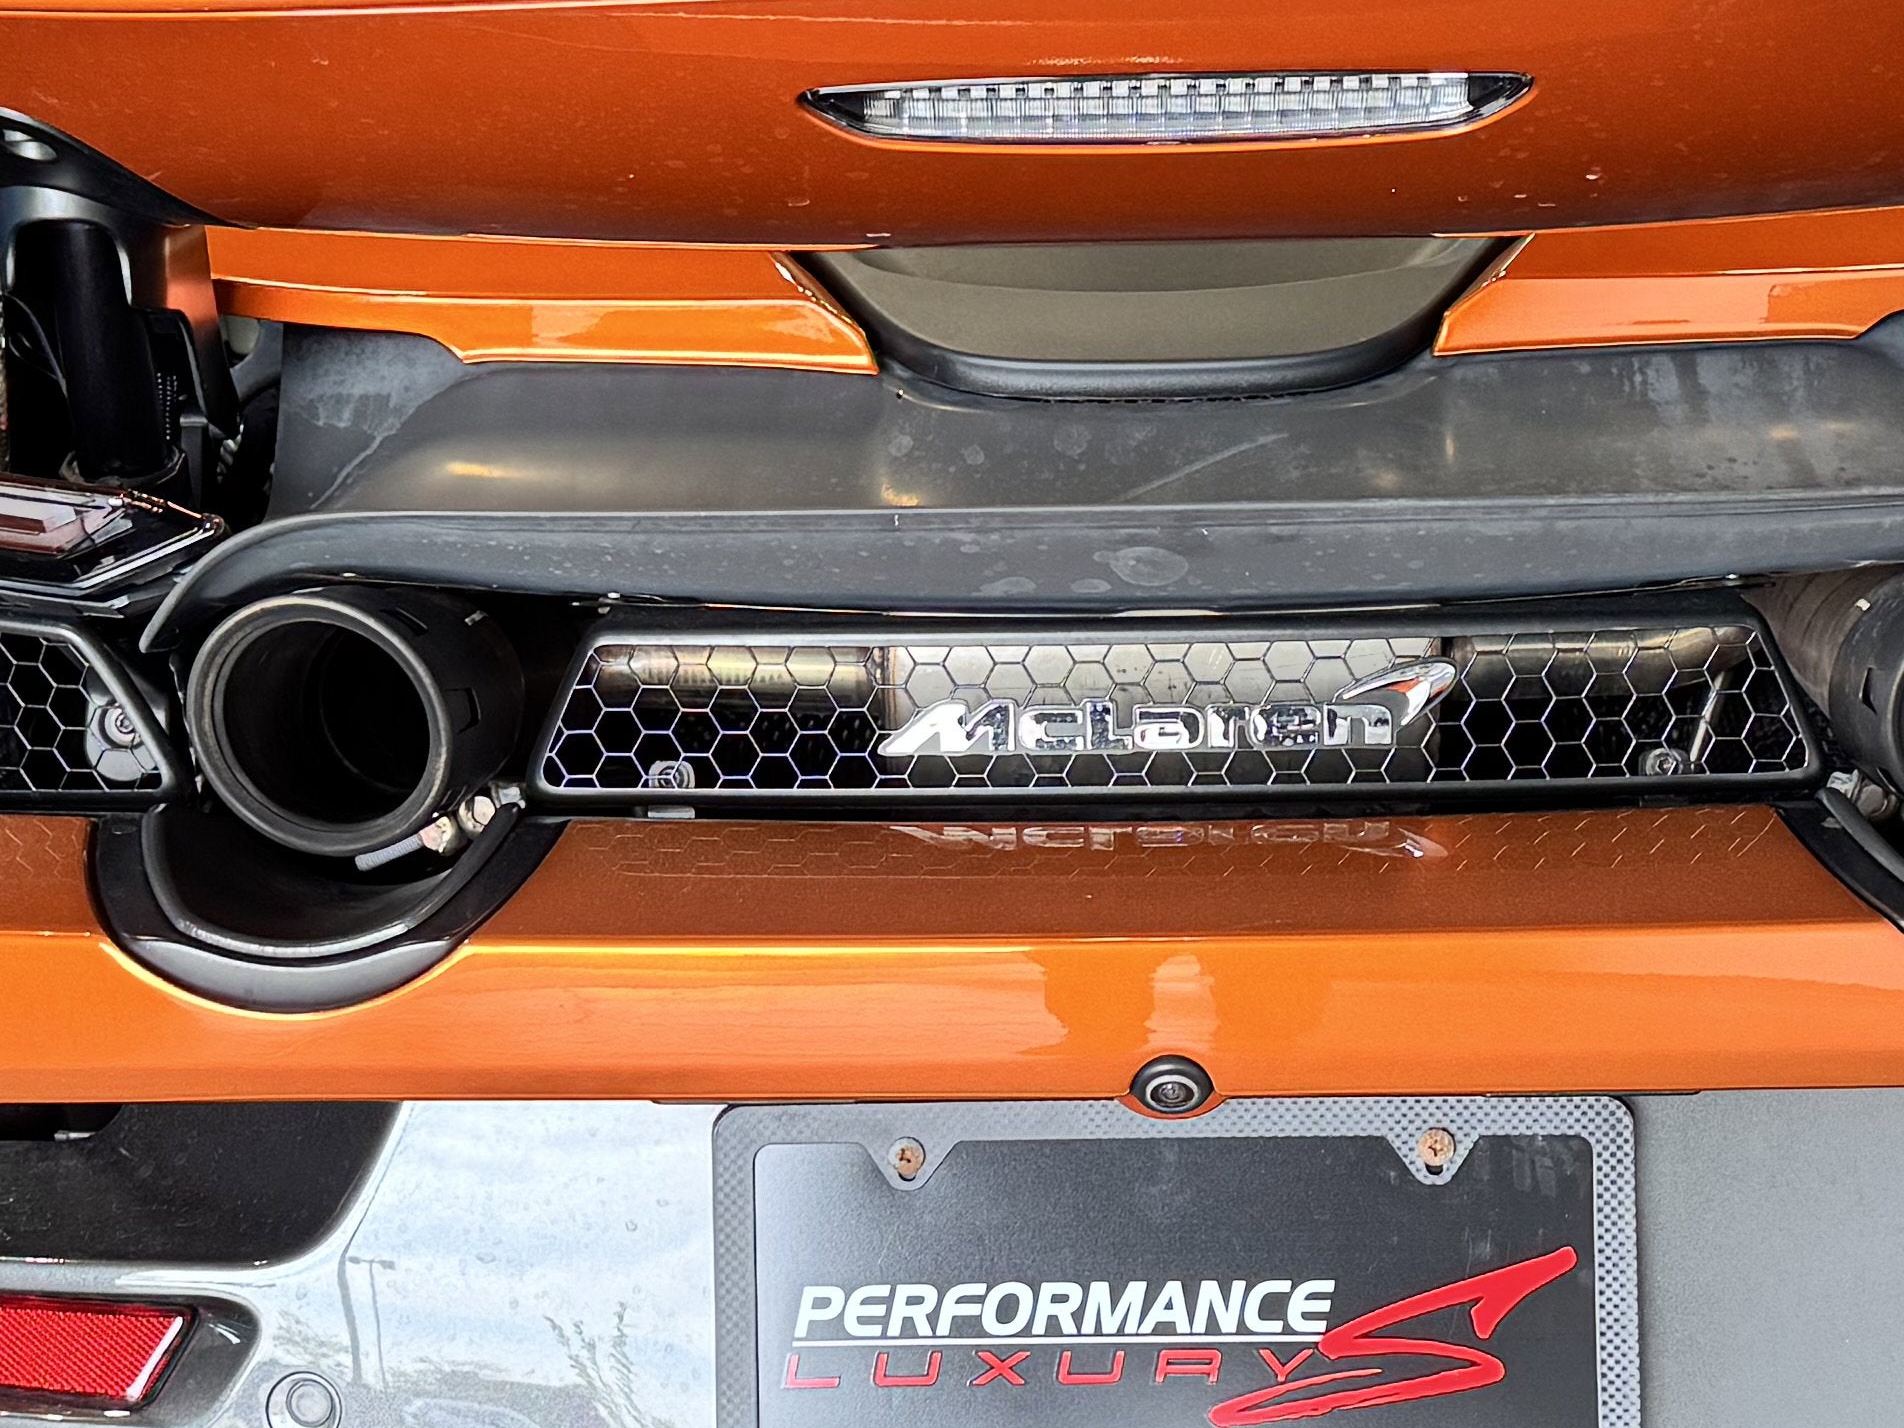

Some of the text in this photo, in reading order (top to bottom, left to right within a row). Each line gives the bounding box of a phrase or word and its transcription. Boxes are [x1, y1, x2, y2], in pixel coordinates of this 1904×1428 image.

[879, 699, 1394, 755] McLaren
[793, 1279, 1336, 1338] PERFORMANCE
[782, 1348, 1315, 1388] LUXURY
